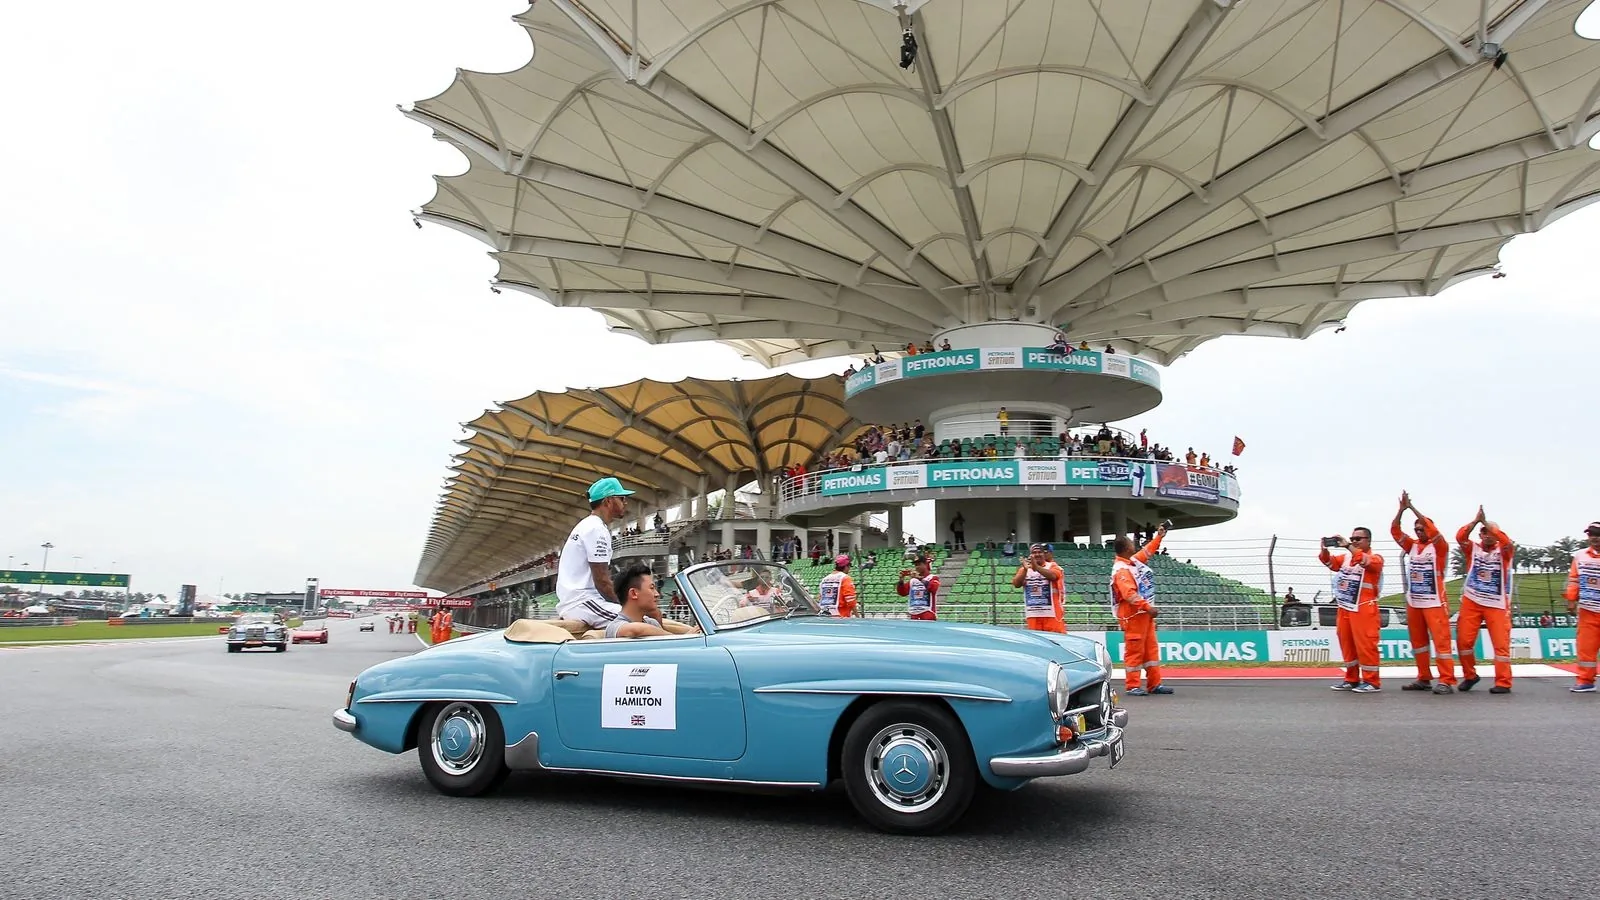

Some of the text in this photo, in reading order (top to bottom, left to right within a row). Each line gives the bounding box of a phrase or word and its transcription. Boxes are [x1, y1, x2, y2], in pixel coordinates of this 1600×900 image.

[906, 353, 974, 372] PETRONAS
[1028, 353, 1097, 367] PETRONAS
[932, 467, 1014, 481] PETRONAS
[824, 473, 881, 490] PETRONAS
[428, 598, 440, 606] Fly
[1282, 638, 1329, 647] PETRONAS
[1283, 648, 1330, 661] SYNTIUM
[625, 686, 652, 695] LEWIS
[614, 697, 662, 706] HAMILTON
